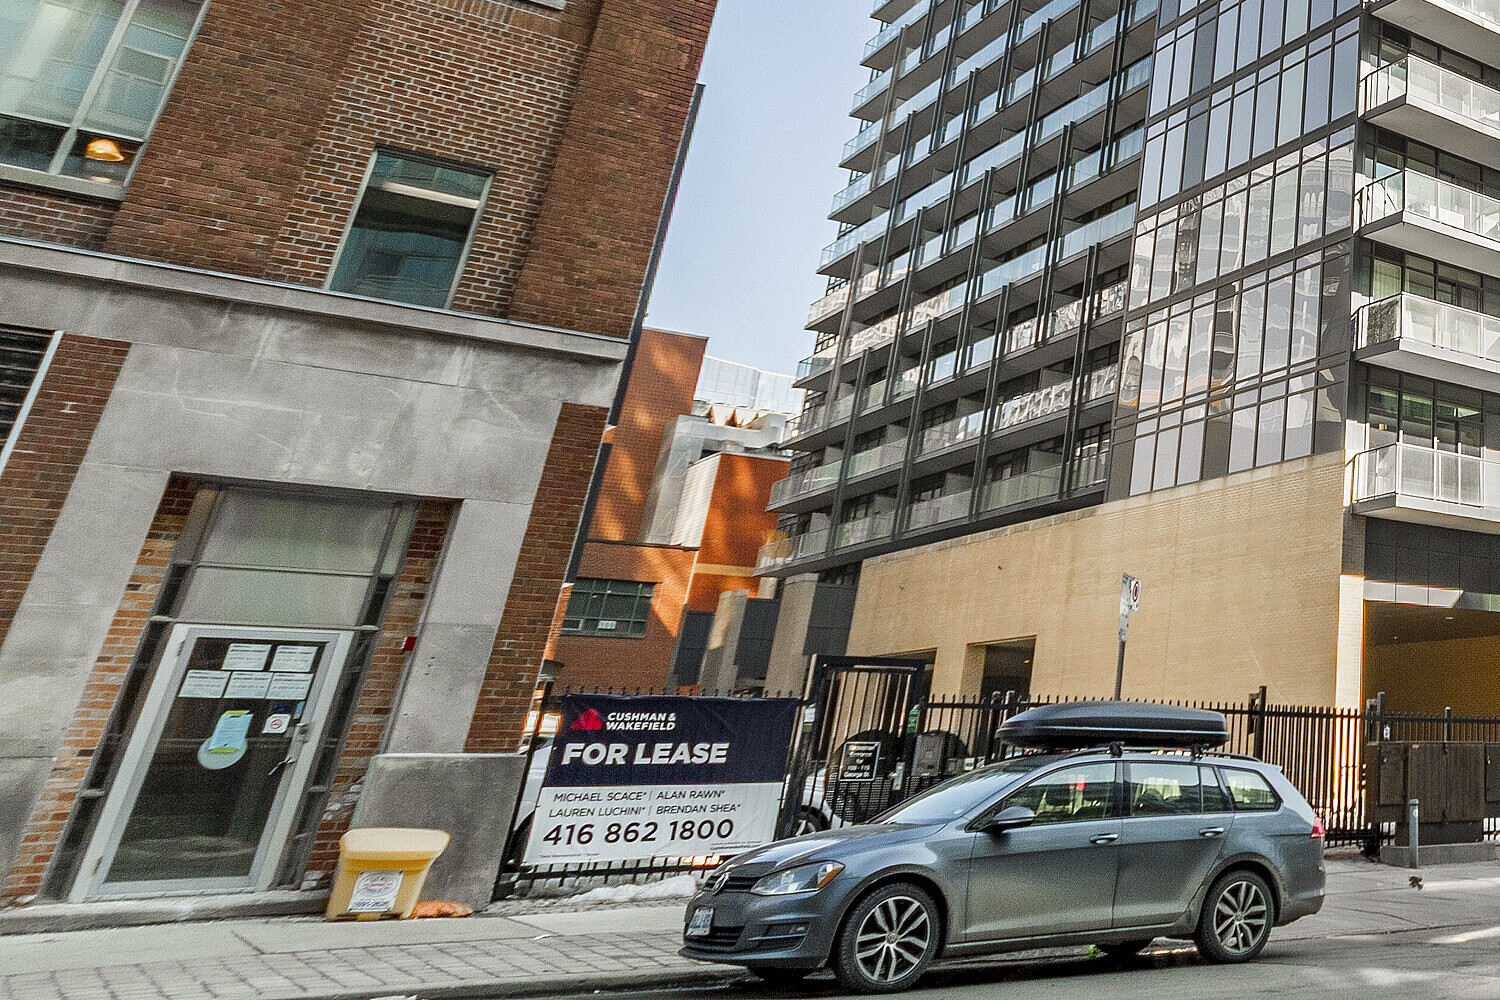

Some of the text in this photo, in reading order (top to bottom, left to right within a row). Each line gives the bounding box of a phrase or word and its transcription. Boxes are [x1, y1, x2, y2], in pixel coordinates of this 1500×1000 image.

[607, 712, 677, 722] CUSHMAN &
[605, 721, 676, 731] WAKEFIELD
[561, 742, 730, 766] FOR LEASE
[553, 792, 603, 803] MICHAEL
[656, 790, 687, 800] ALAN
[549, 807, 595, 818] LAUREN
[656, 804, 708, 815] BRENDAN
[543, 818, 734, 846] 416 862 1800
